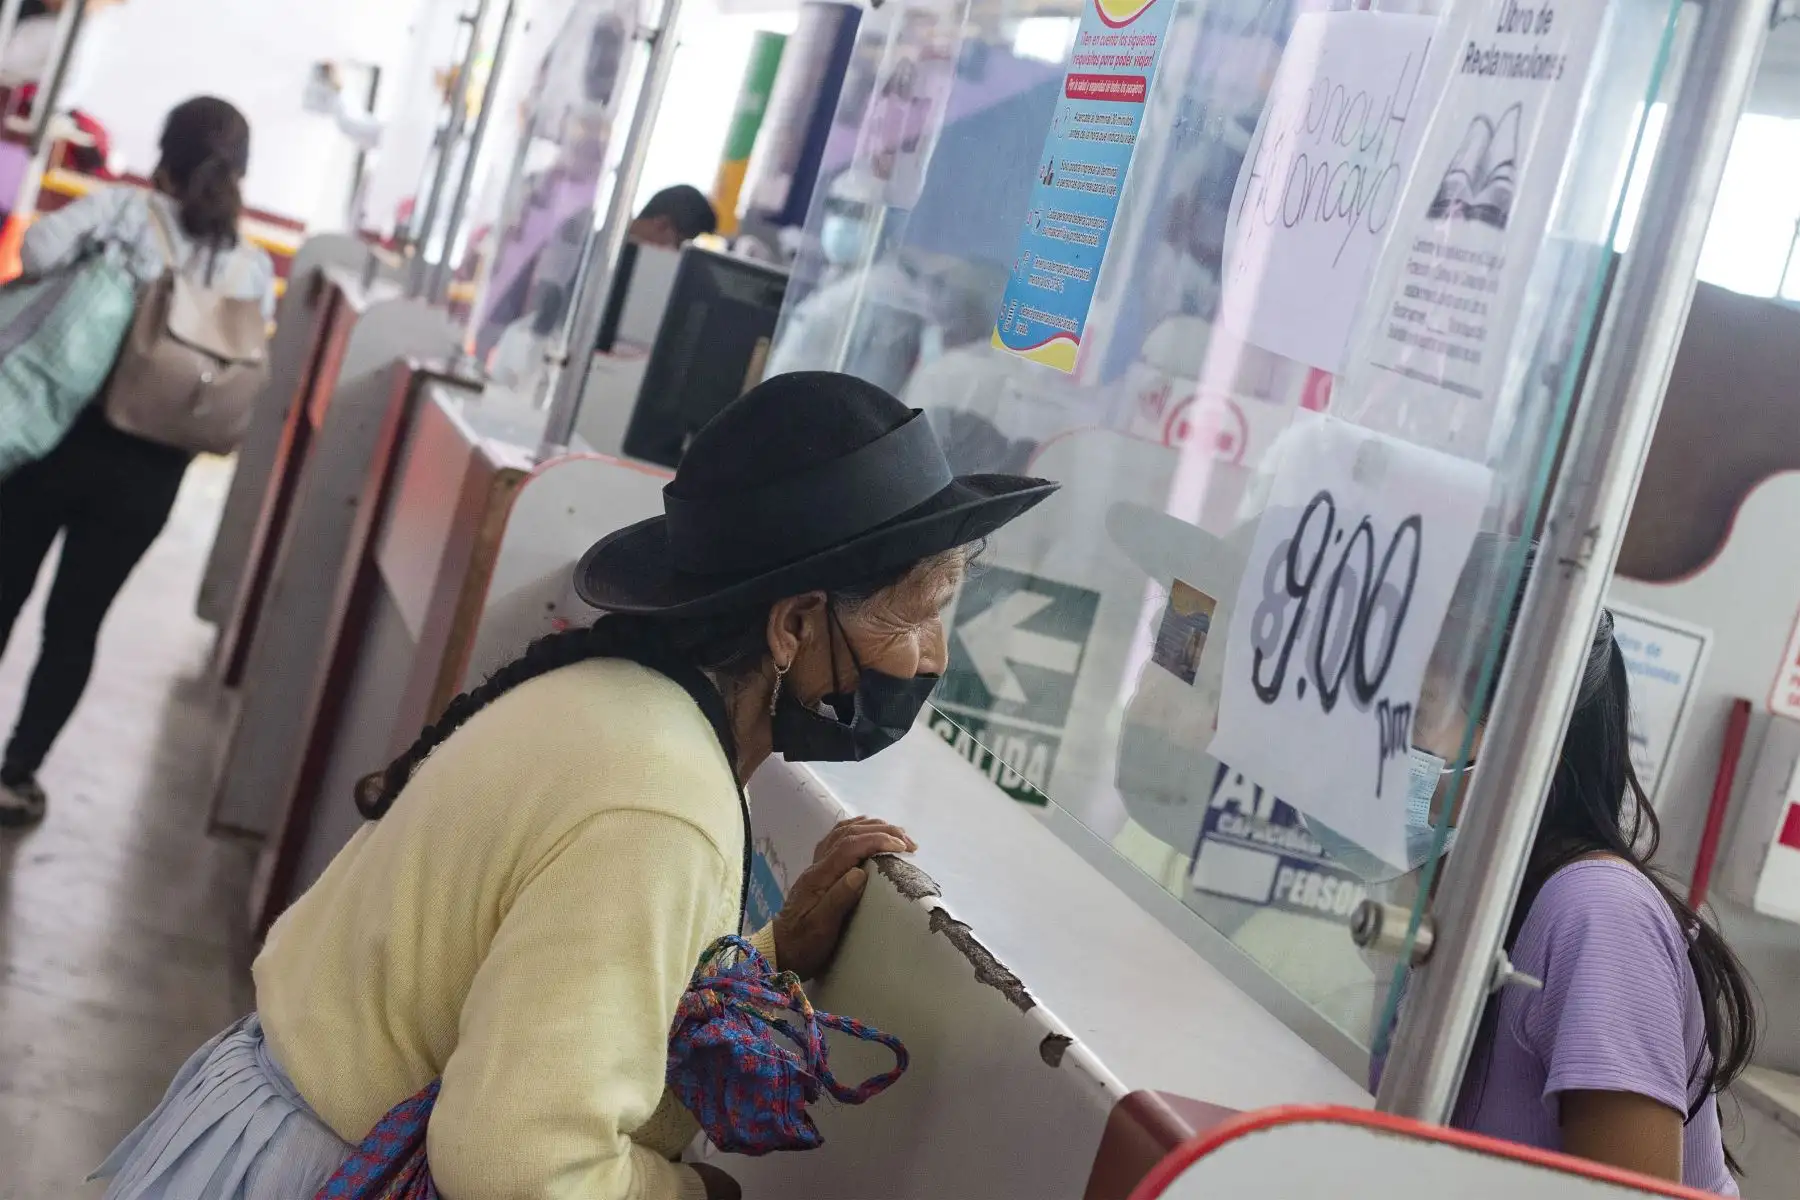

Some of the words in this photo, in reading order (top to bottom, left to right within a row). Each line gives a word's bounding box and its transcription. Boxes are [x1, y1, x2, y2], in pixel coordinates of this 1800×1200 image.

[1251, 489, 1422, 714] 9:00
[1374, 698, 1411, 798] pm
[932, 718, 1049, 797] SALIDA
